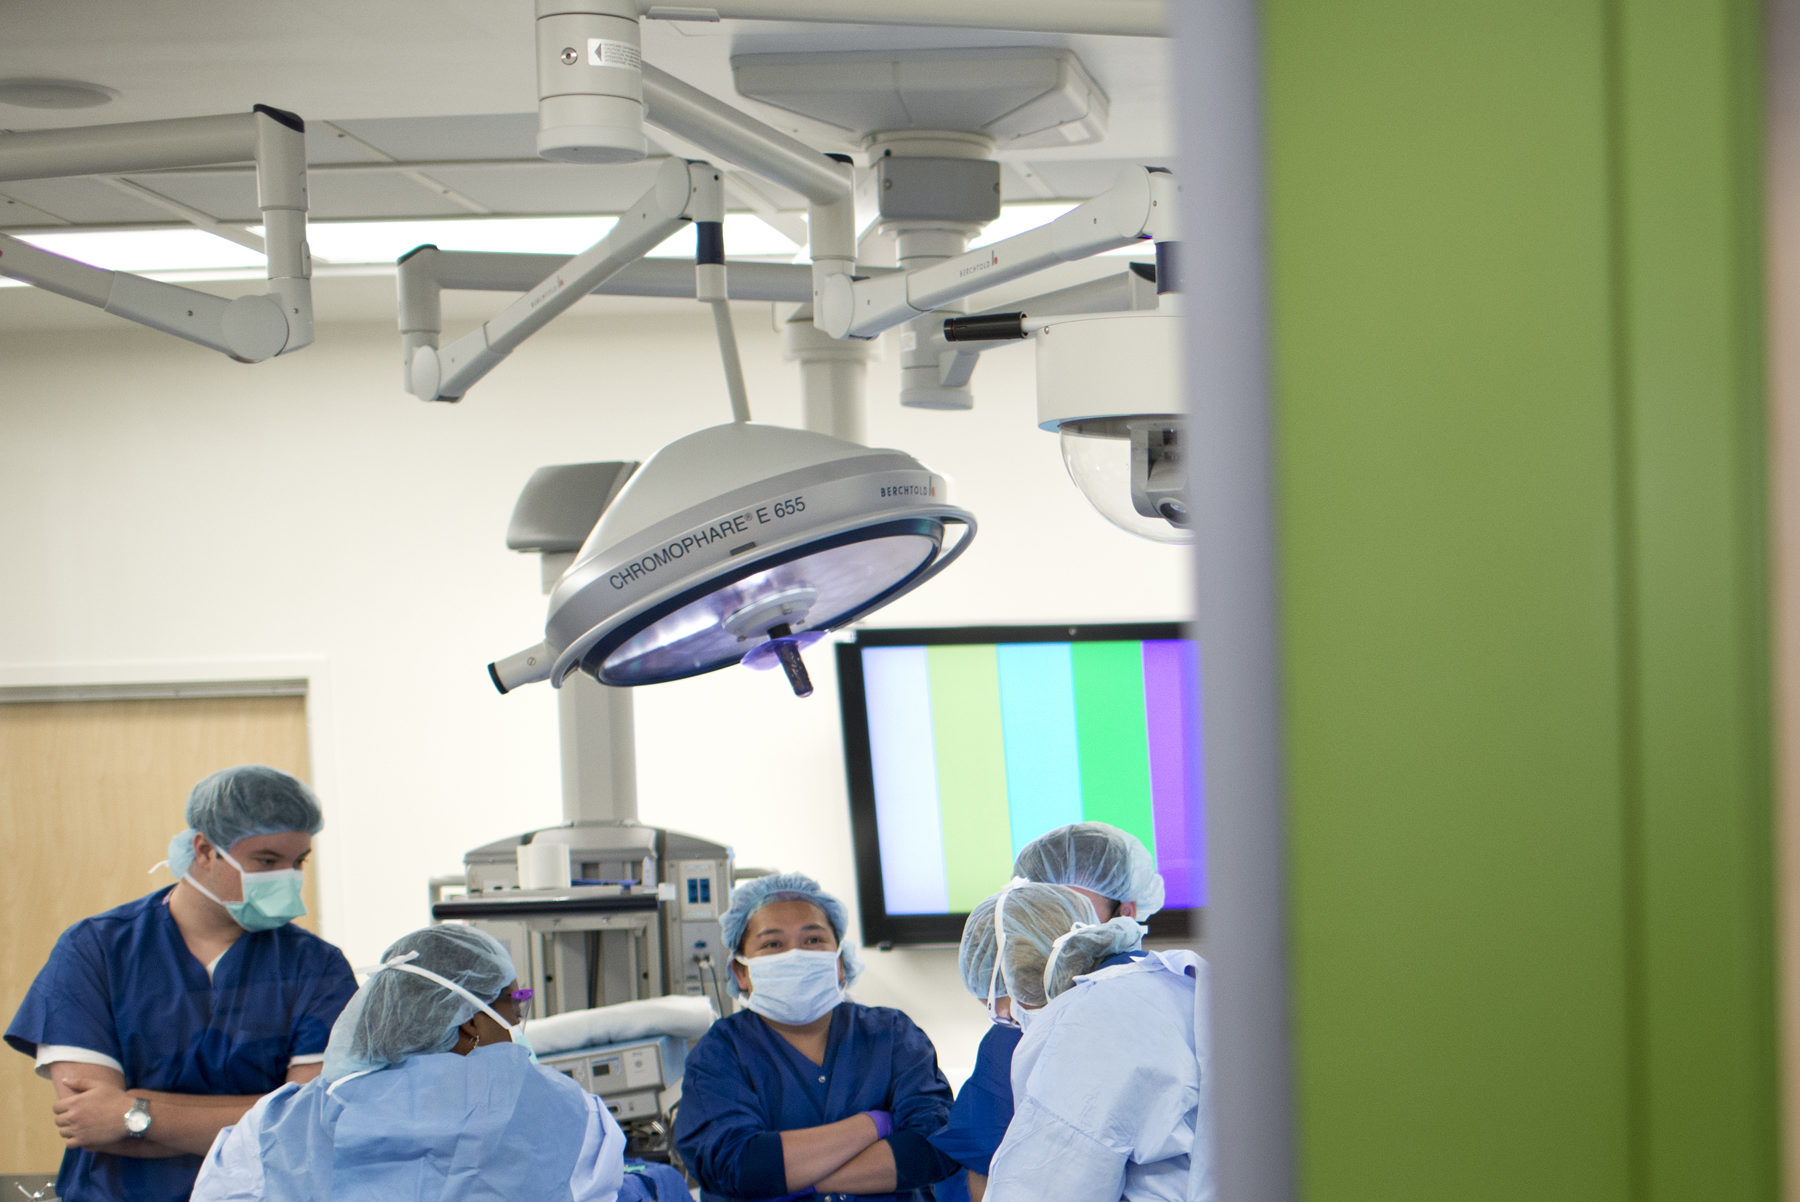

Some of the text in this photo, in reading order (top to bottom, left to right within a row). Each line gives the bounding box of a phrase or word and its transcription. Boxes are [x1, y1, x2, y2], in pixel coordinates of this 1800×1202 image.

[880, 485, 928, 497] BERCHTOLD
[756, 506, 771, 524] E
[774, 496, 806, 518] 655
